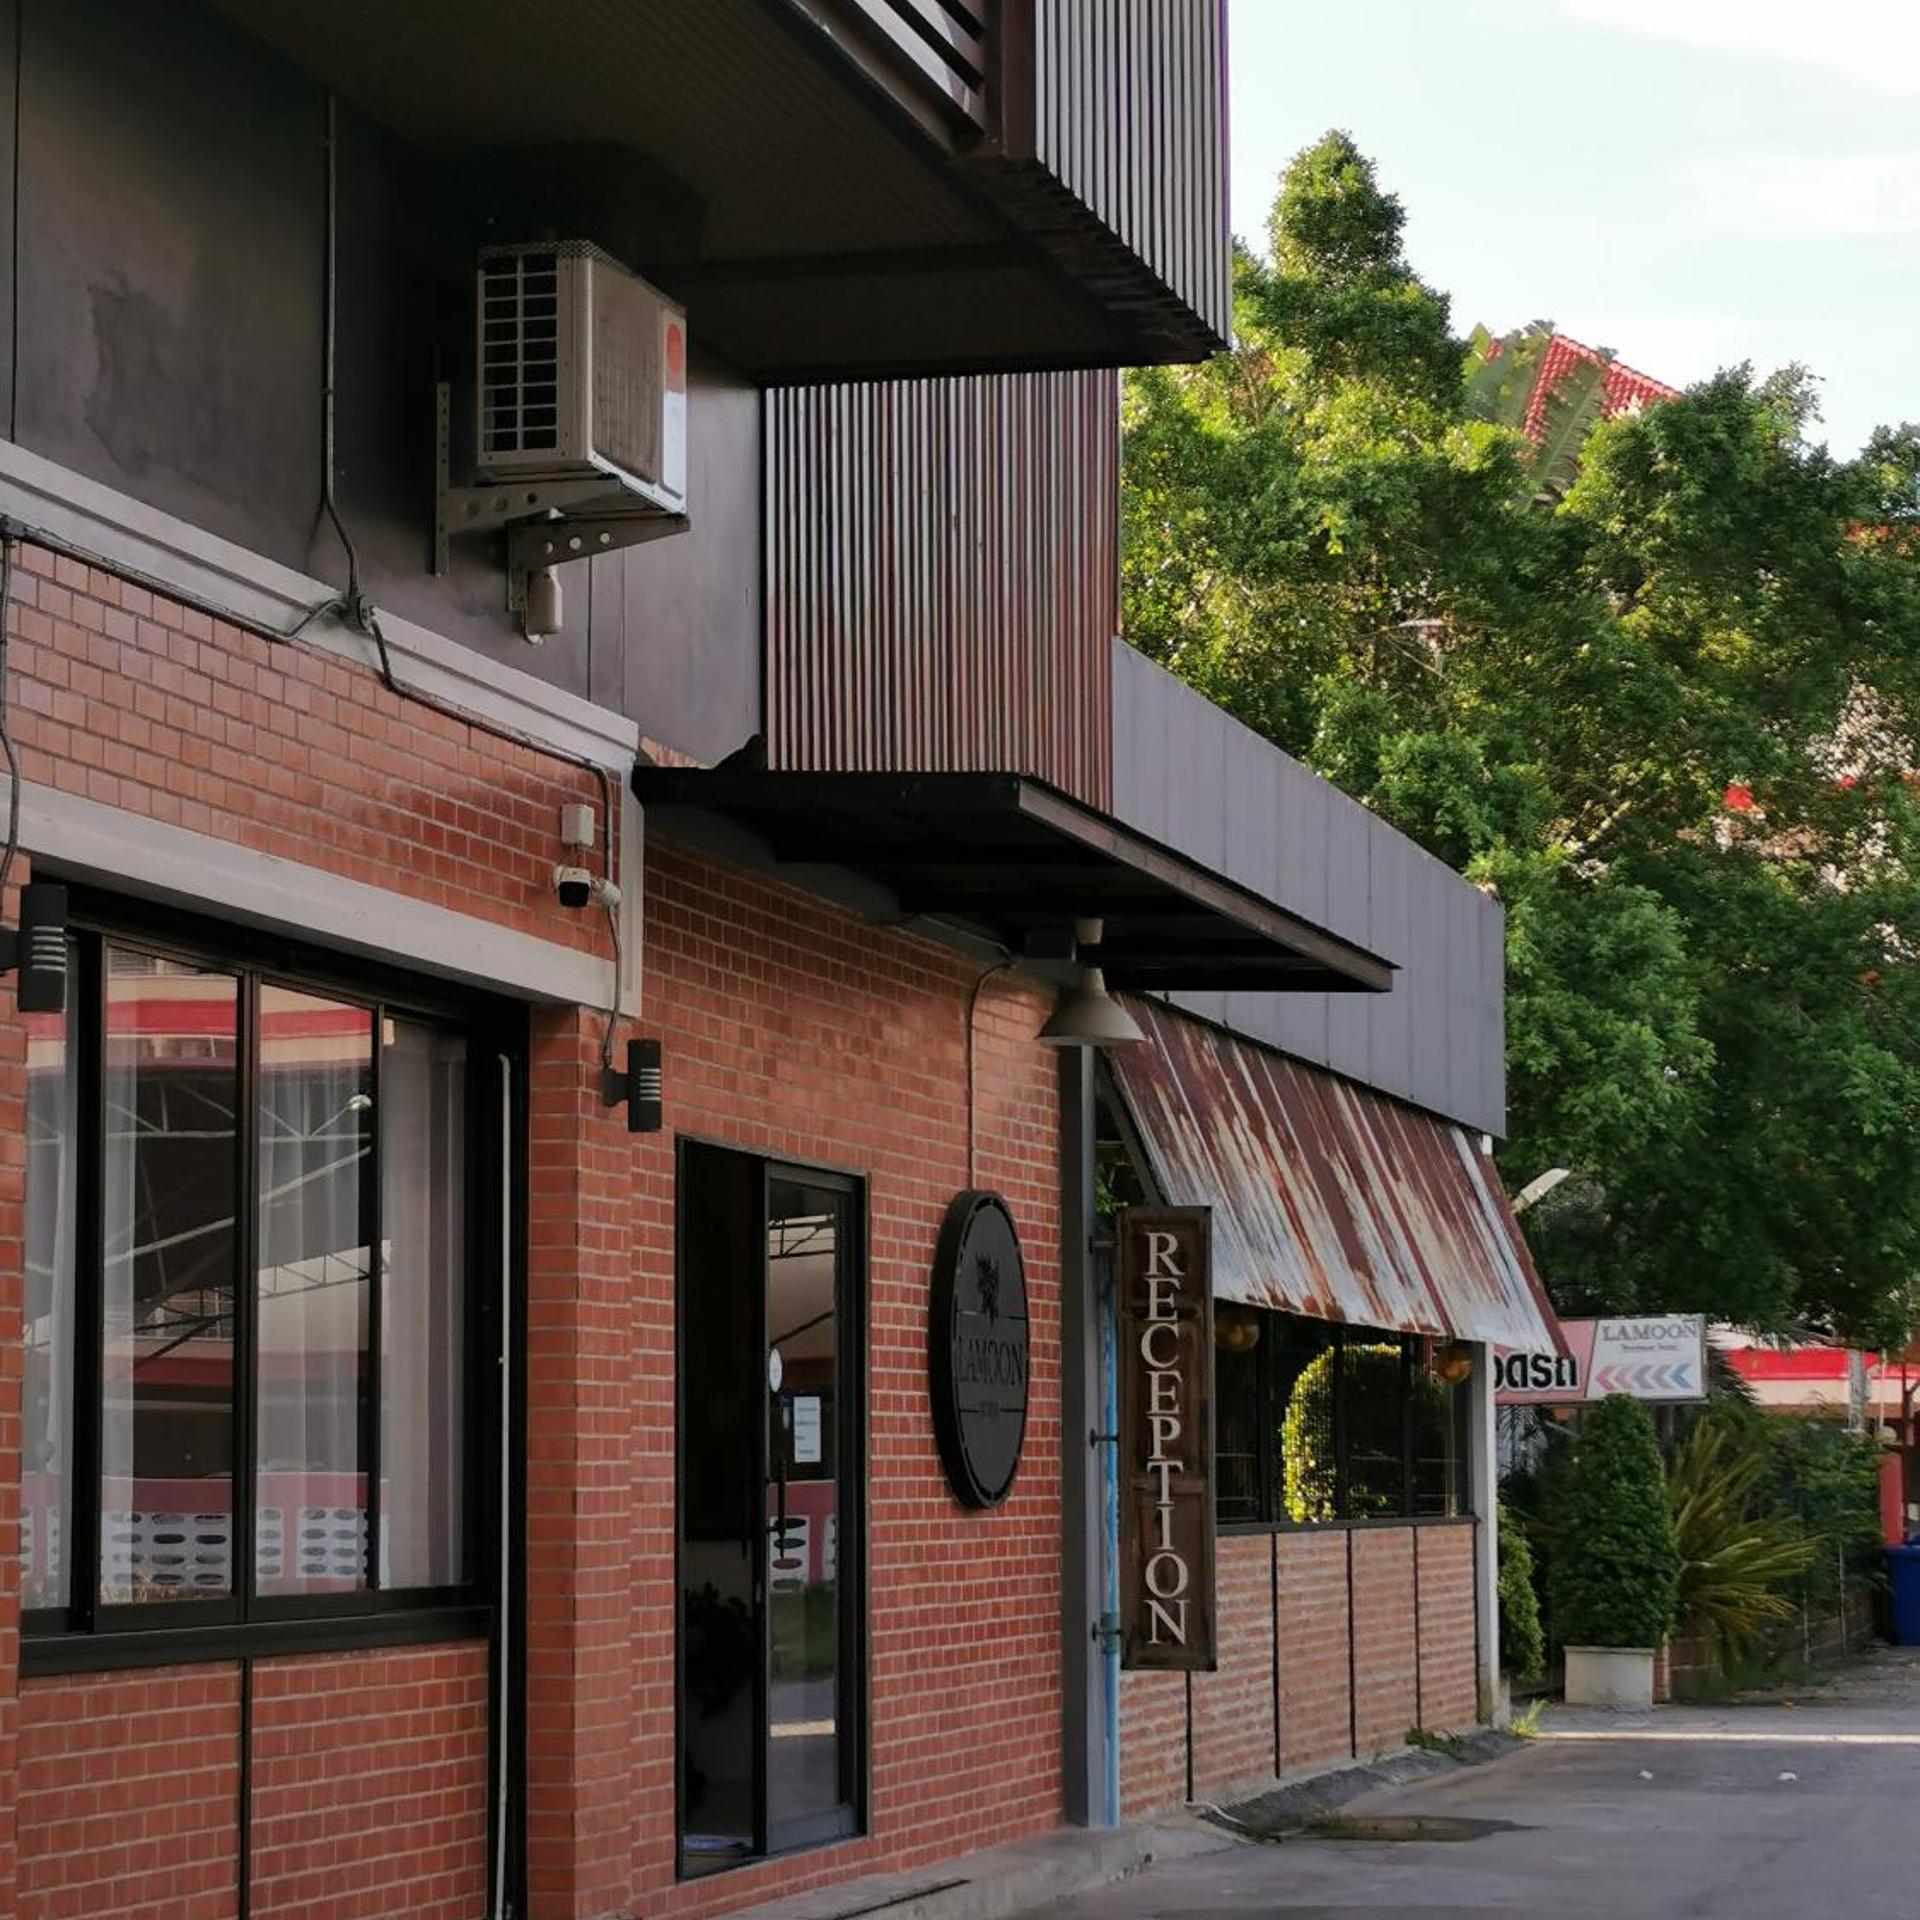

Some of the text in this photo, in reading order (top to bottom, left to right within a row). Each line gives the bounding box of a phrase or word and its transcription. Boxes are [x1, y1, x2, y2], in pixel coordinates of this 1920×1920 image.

[1601, 1323, 1697, 1341] LAMOON
[956, 1335, 1023, 1387] LAMOON
[1141, 1231, 1191, 1646] RECEPTION
